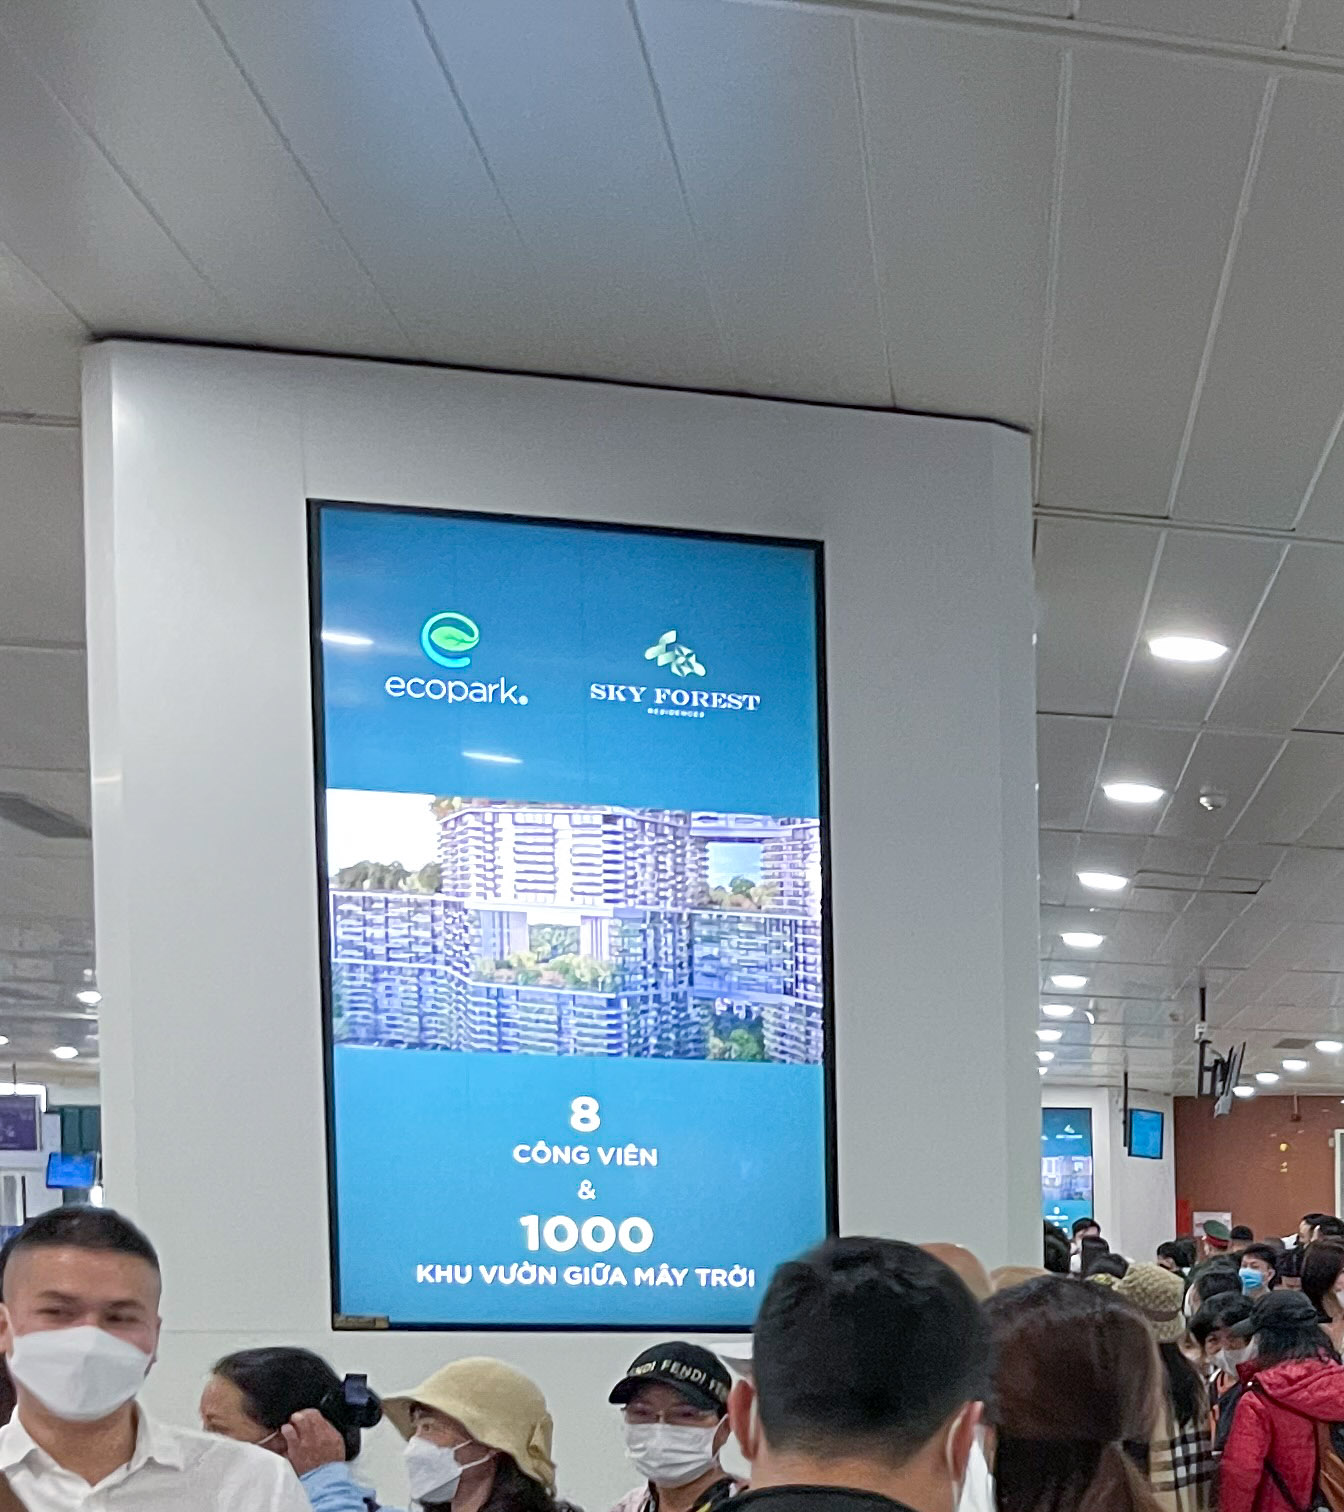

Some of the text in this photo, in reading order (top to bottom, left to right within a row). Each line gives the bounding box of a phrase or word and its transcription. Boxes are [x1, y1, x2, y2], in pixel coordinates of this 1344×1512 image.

[590, 682, 762, 712] SKY FOREST
[570, 1095, 602, 1133] 8
[513, 1140, 658, 1167] CÔNG VIÊN
[577, 1179, 597, 1200] &
[519, 1214, 655, 1254] 1000
[416, 1261, 756, 1288] KHU VƯỜN GIỮA MÂY TRỜI
[660, 1359, 707, 1385] FENDI
